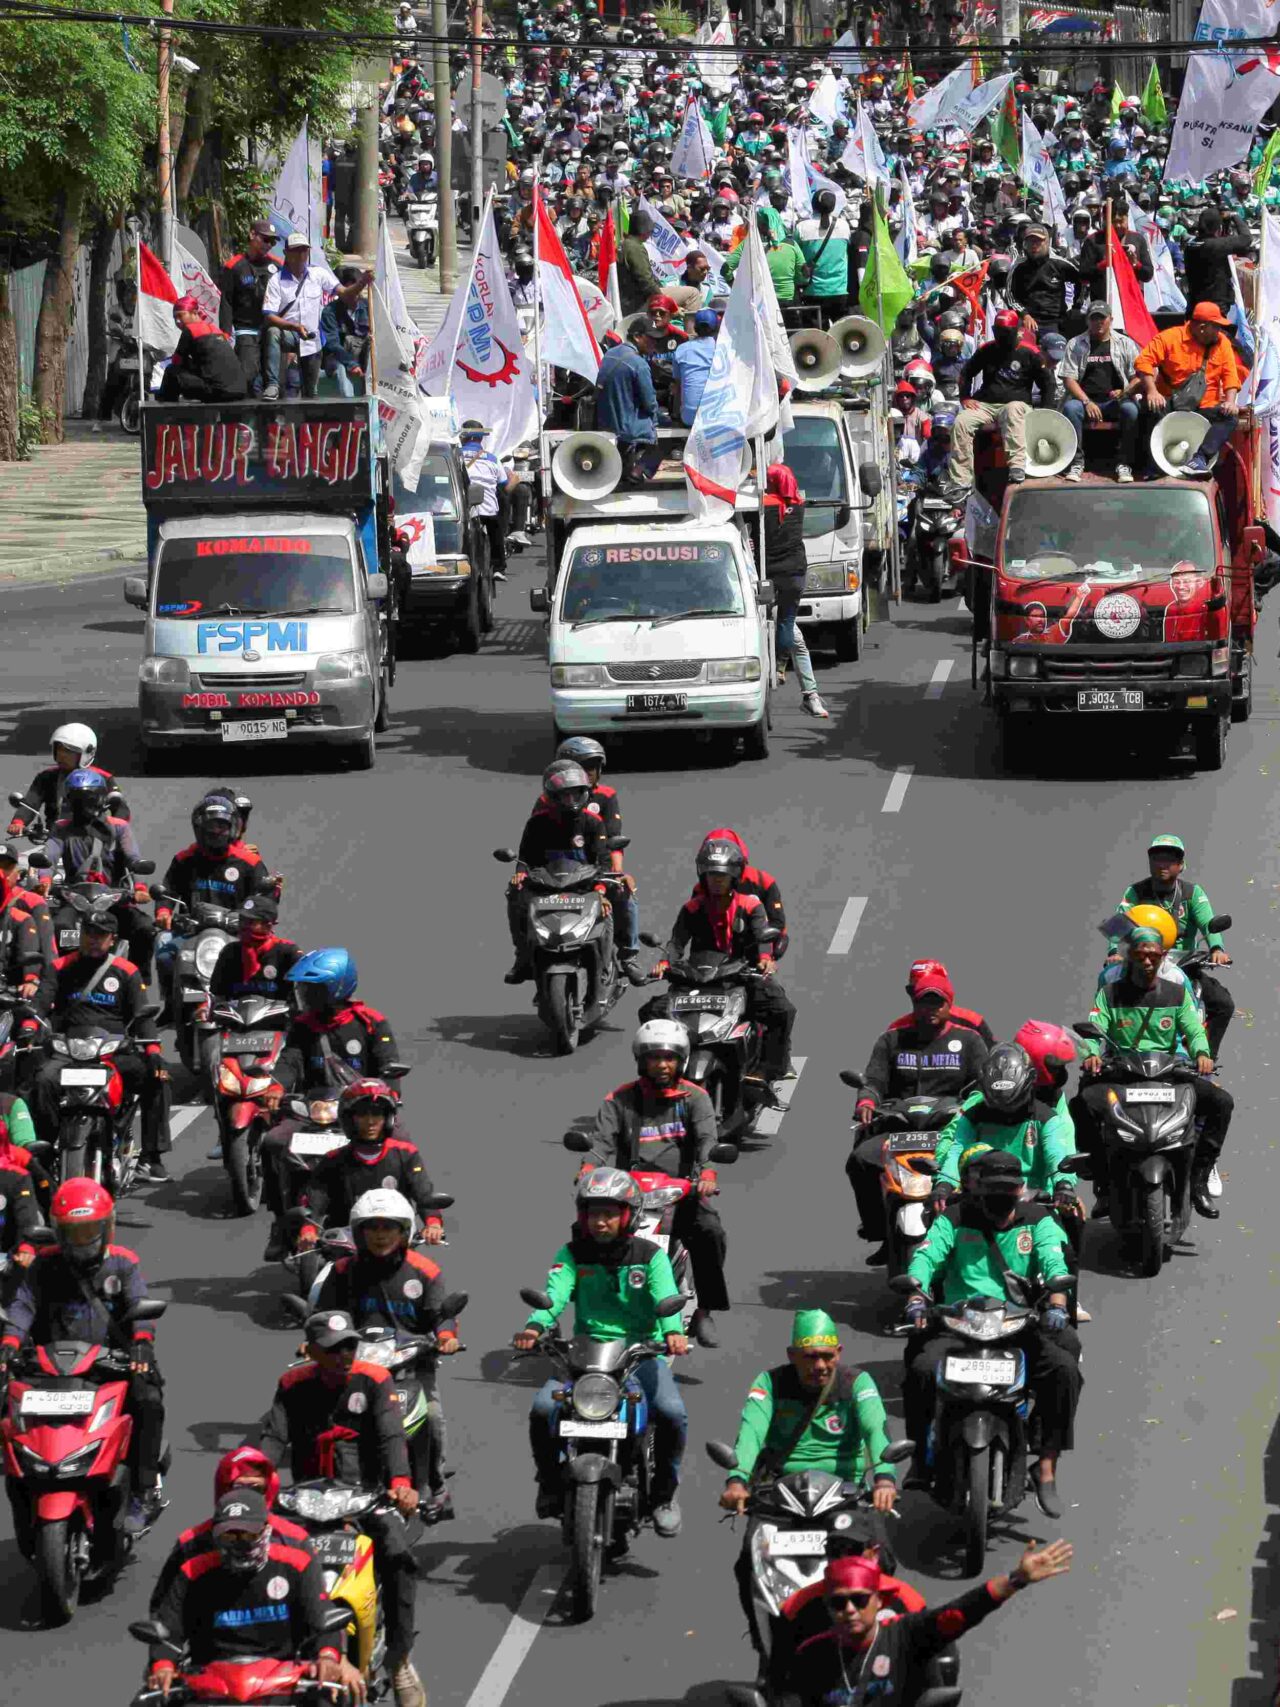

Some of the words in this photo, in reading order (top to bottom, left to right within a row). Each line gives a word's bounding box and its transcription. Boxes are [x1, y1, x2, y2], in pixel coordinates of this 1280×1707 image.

[146, 422, 254, 489] JALUR
[266, 421, 367, 486] LANGIT
[197, 538, 312, 556] KOMANDO
[606, 546, 698, 562] RESOLUSI
[197, 622, 308, 653] FSPMI
[181, 693, 231, 708] MOBIL
[238, 691, 320, 707] KOMANDO
[643, 695, 665, 706] 1674
[675, 694, 687, 705] YR
[1091, 693, 1115, 704] 9034
[1124, 693, 1141, 704] TCB
[272, 721, 285, 732] NG
[931, 1053, 961, 1066] METAL
